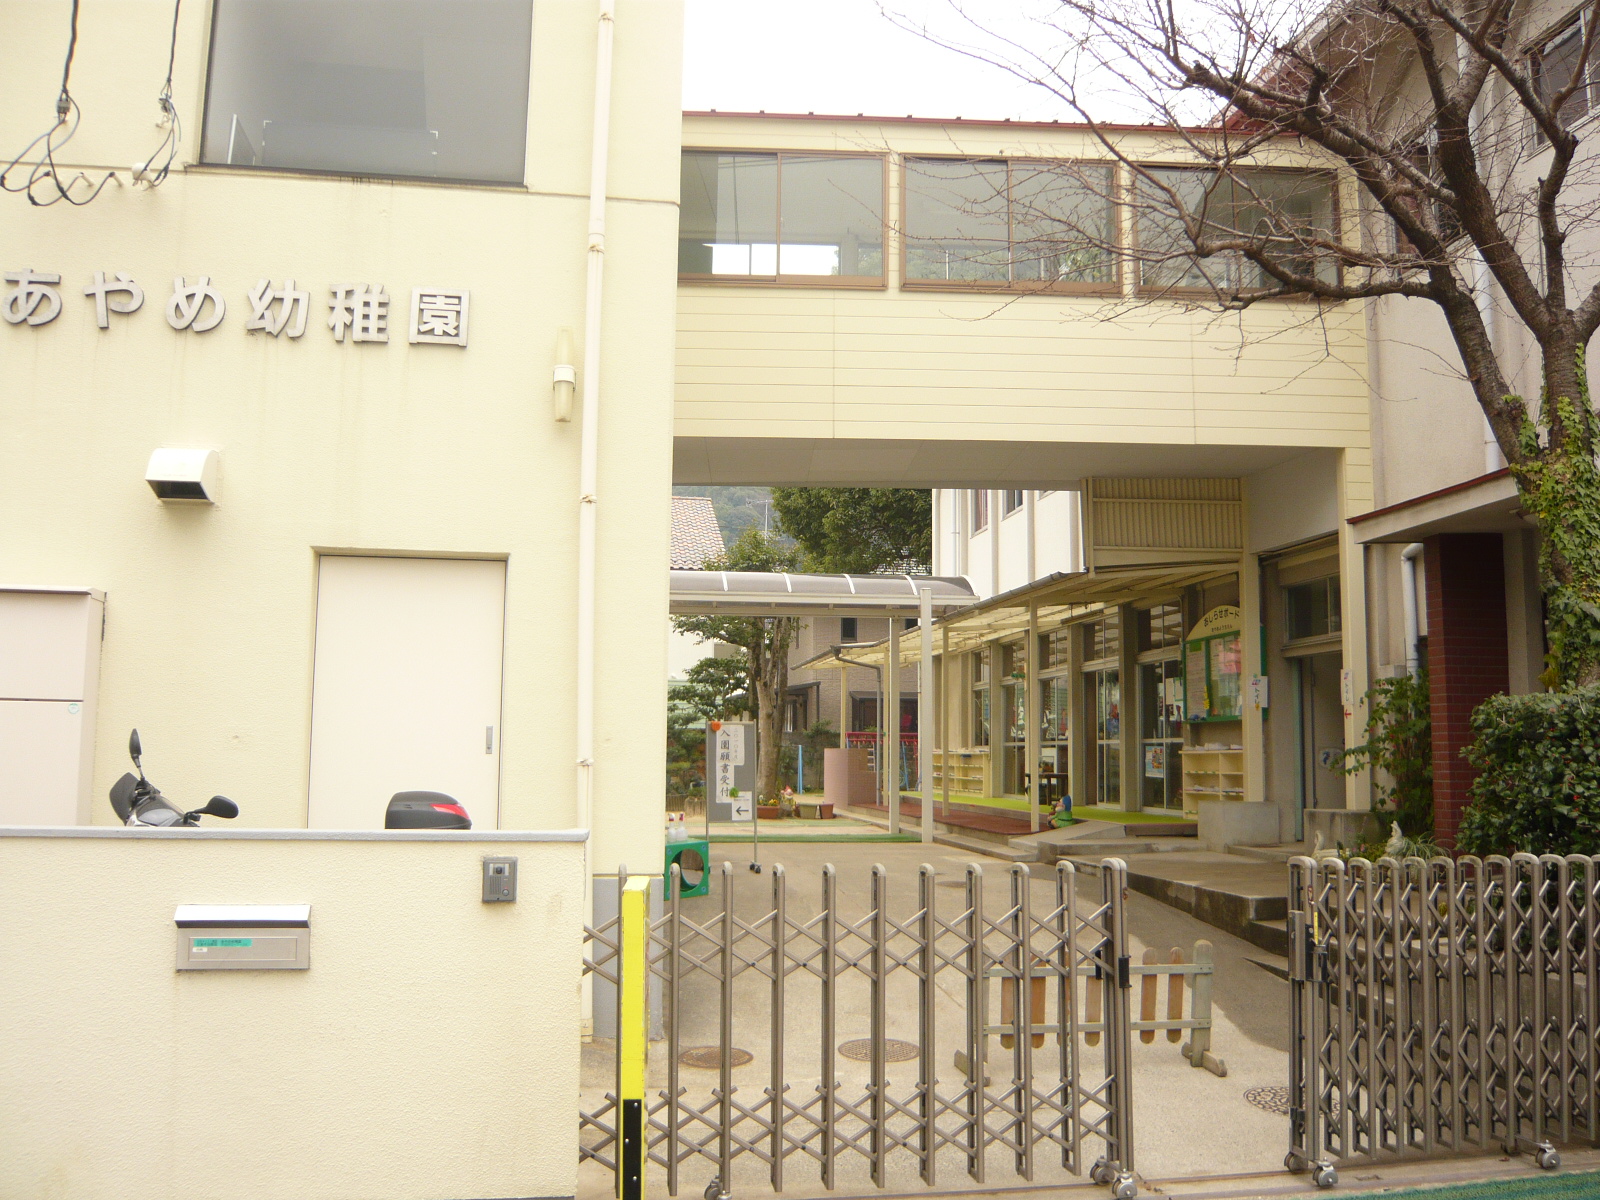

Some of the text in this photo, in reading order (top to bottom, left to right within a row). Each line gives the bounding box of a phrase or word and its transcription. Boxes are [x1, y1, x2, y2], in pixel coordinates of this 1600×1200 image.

[1, 268, 471, 347] あやめ幼稚園
[1203, 607, 1240, 628] おしらせボード
[720, 729, 731, 798] 入園願書受付
